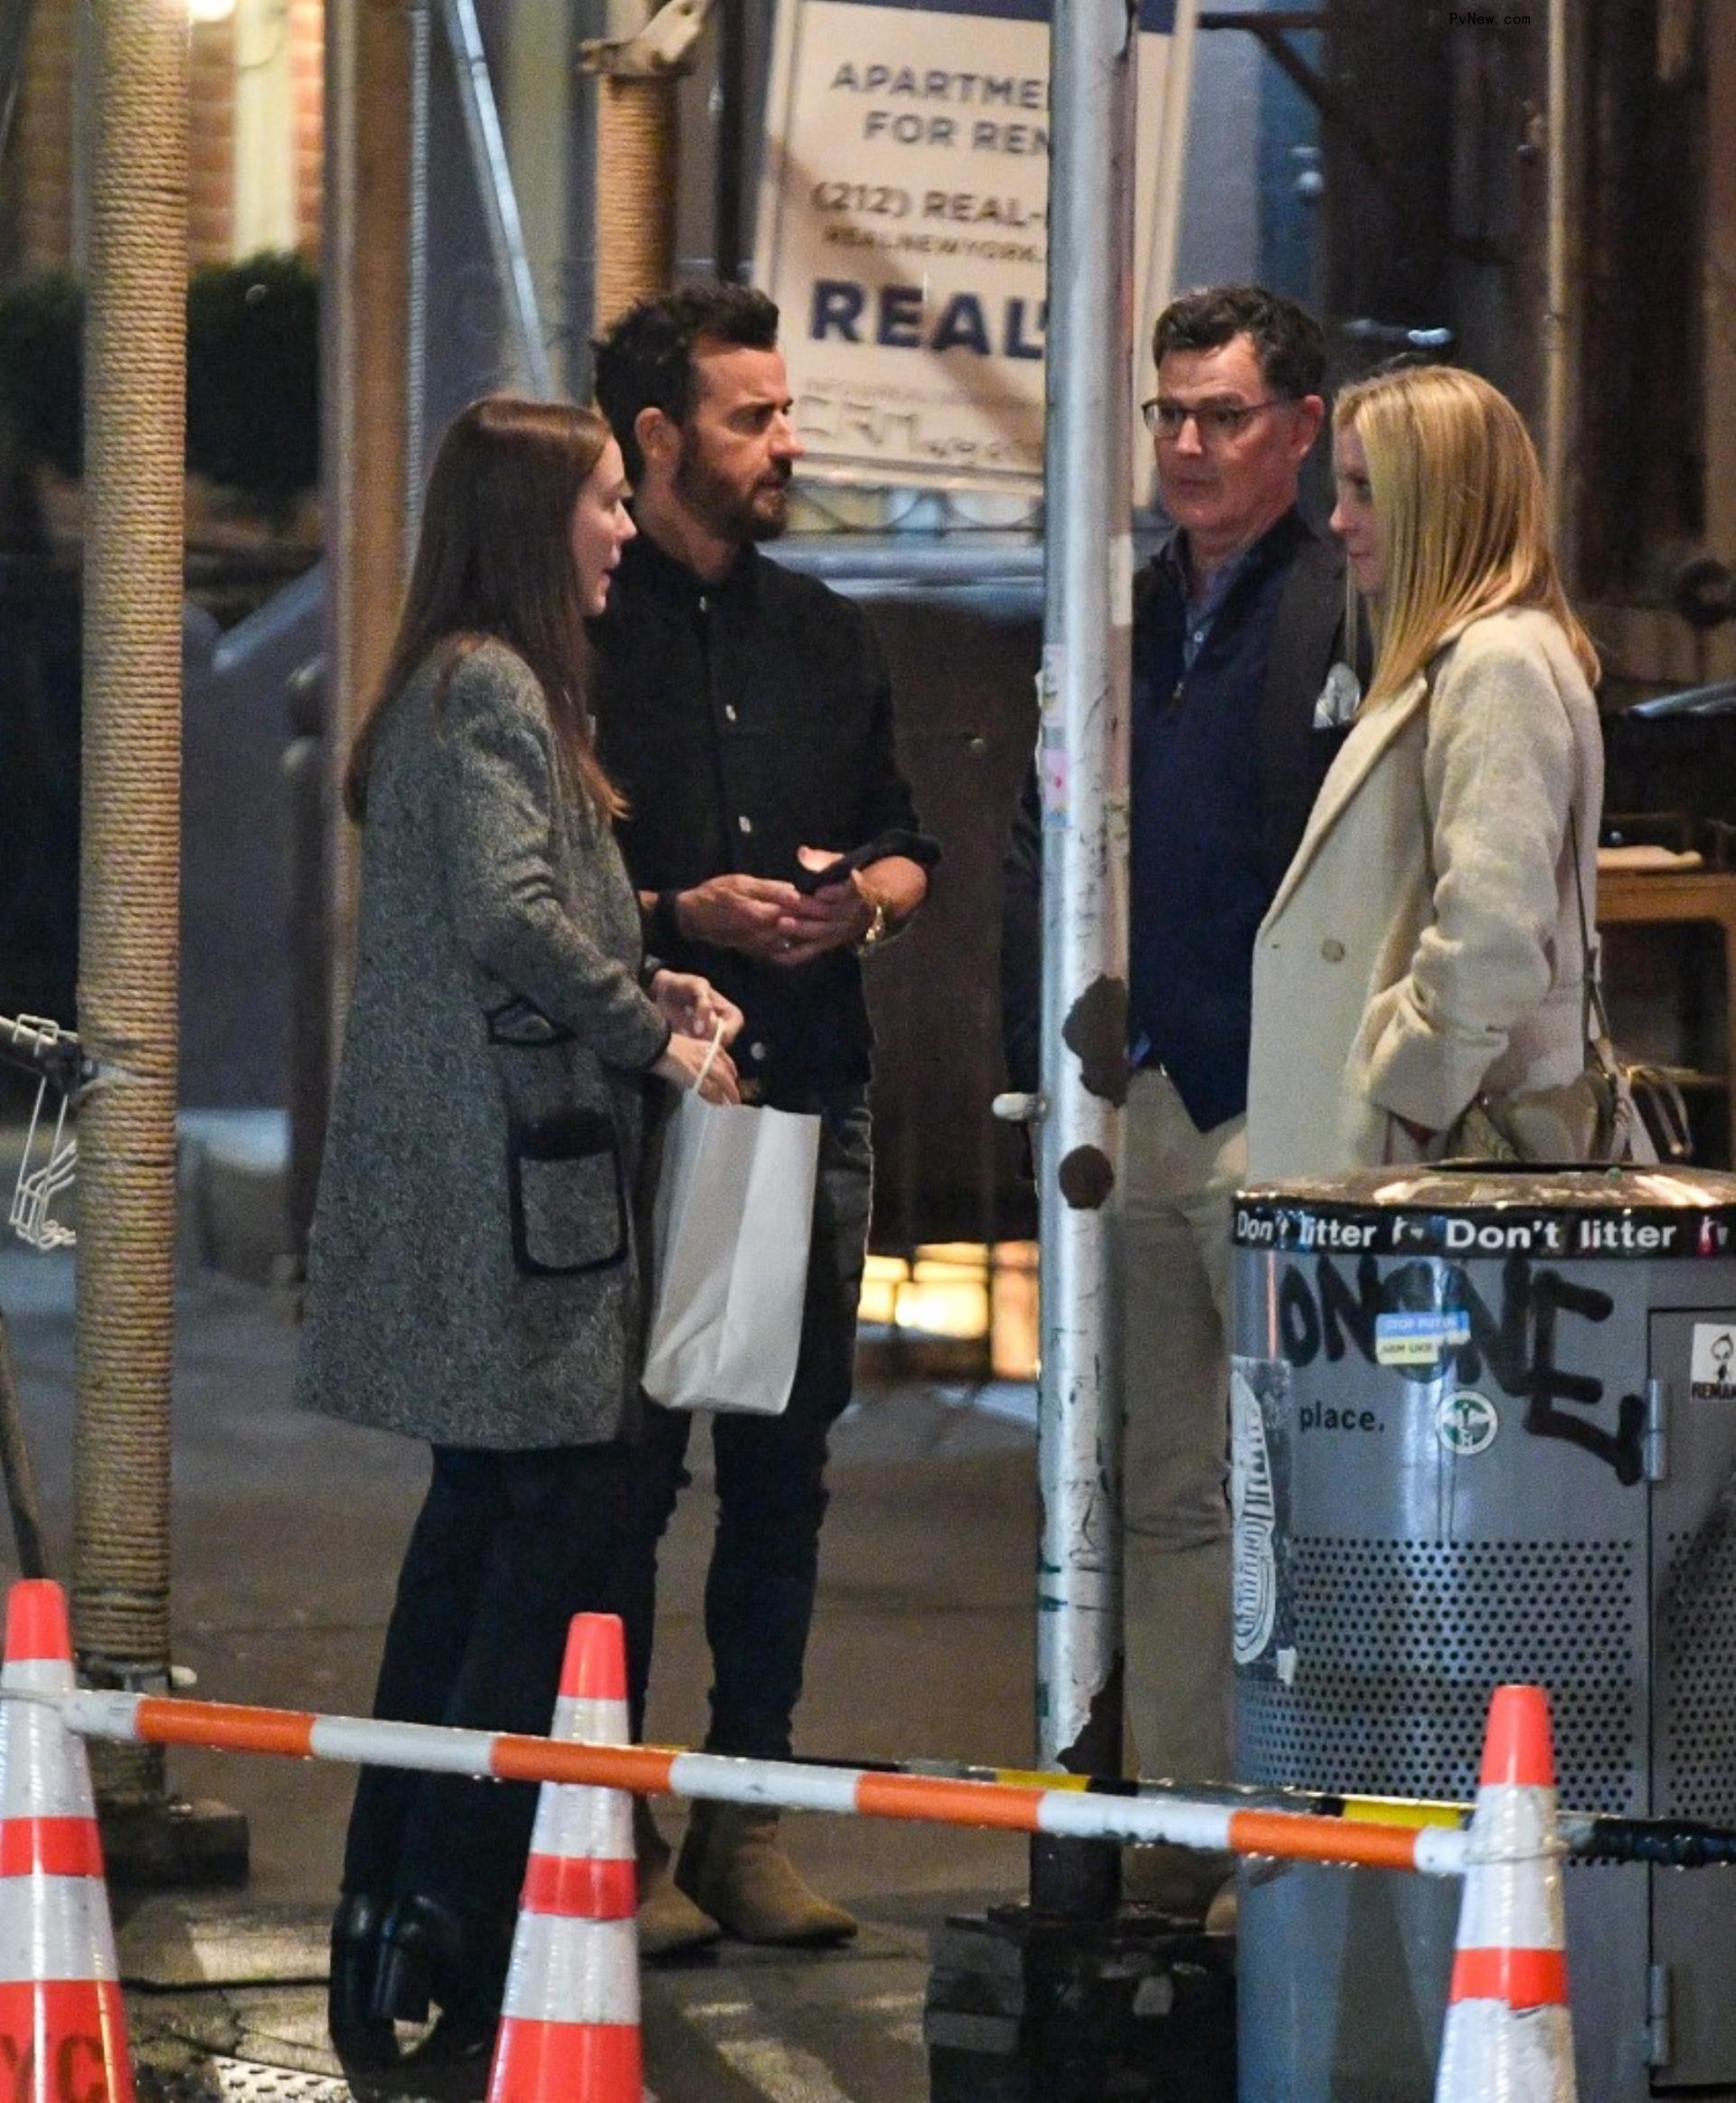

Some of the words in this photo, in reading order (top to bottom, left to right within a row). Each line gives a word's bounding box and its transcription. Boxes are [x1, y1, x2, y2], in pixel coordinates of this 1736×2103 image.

[863, 110, 956, 146] FOR
[812, 181, 910, 218] (212)
[810, 280, 1047, 360] REAL
[1447, 1219, 1560, 1250] Don't
[1581, 1219, 1676, 1250] litter
[1299, 1401, 1385, 1432] place.
